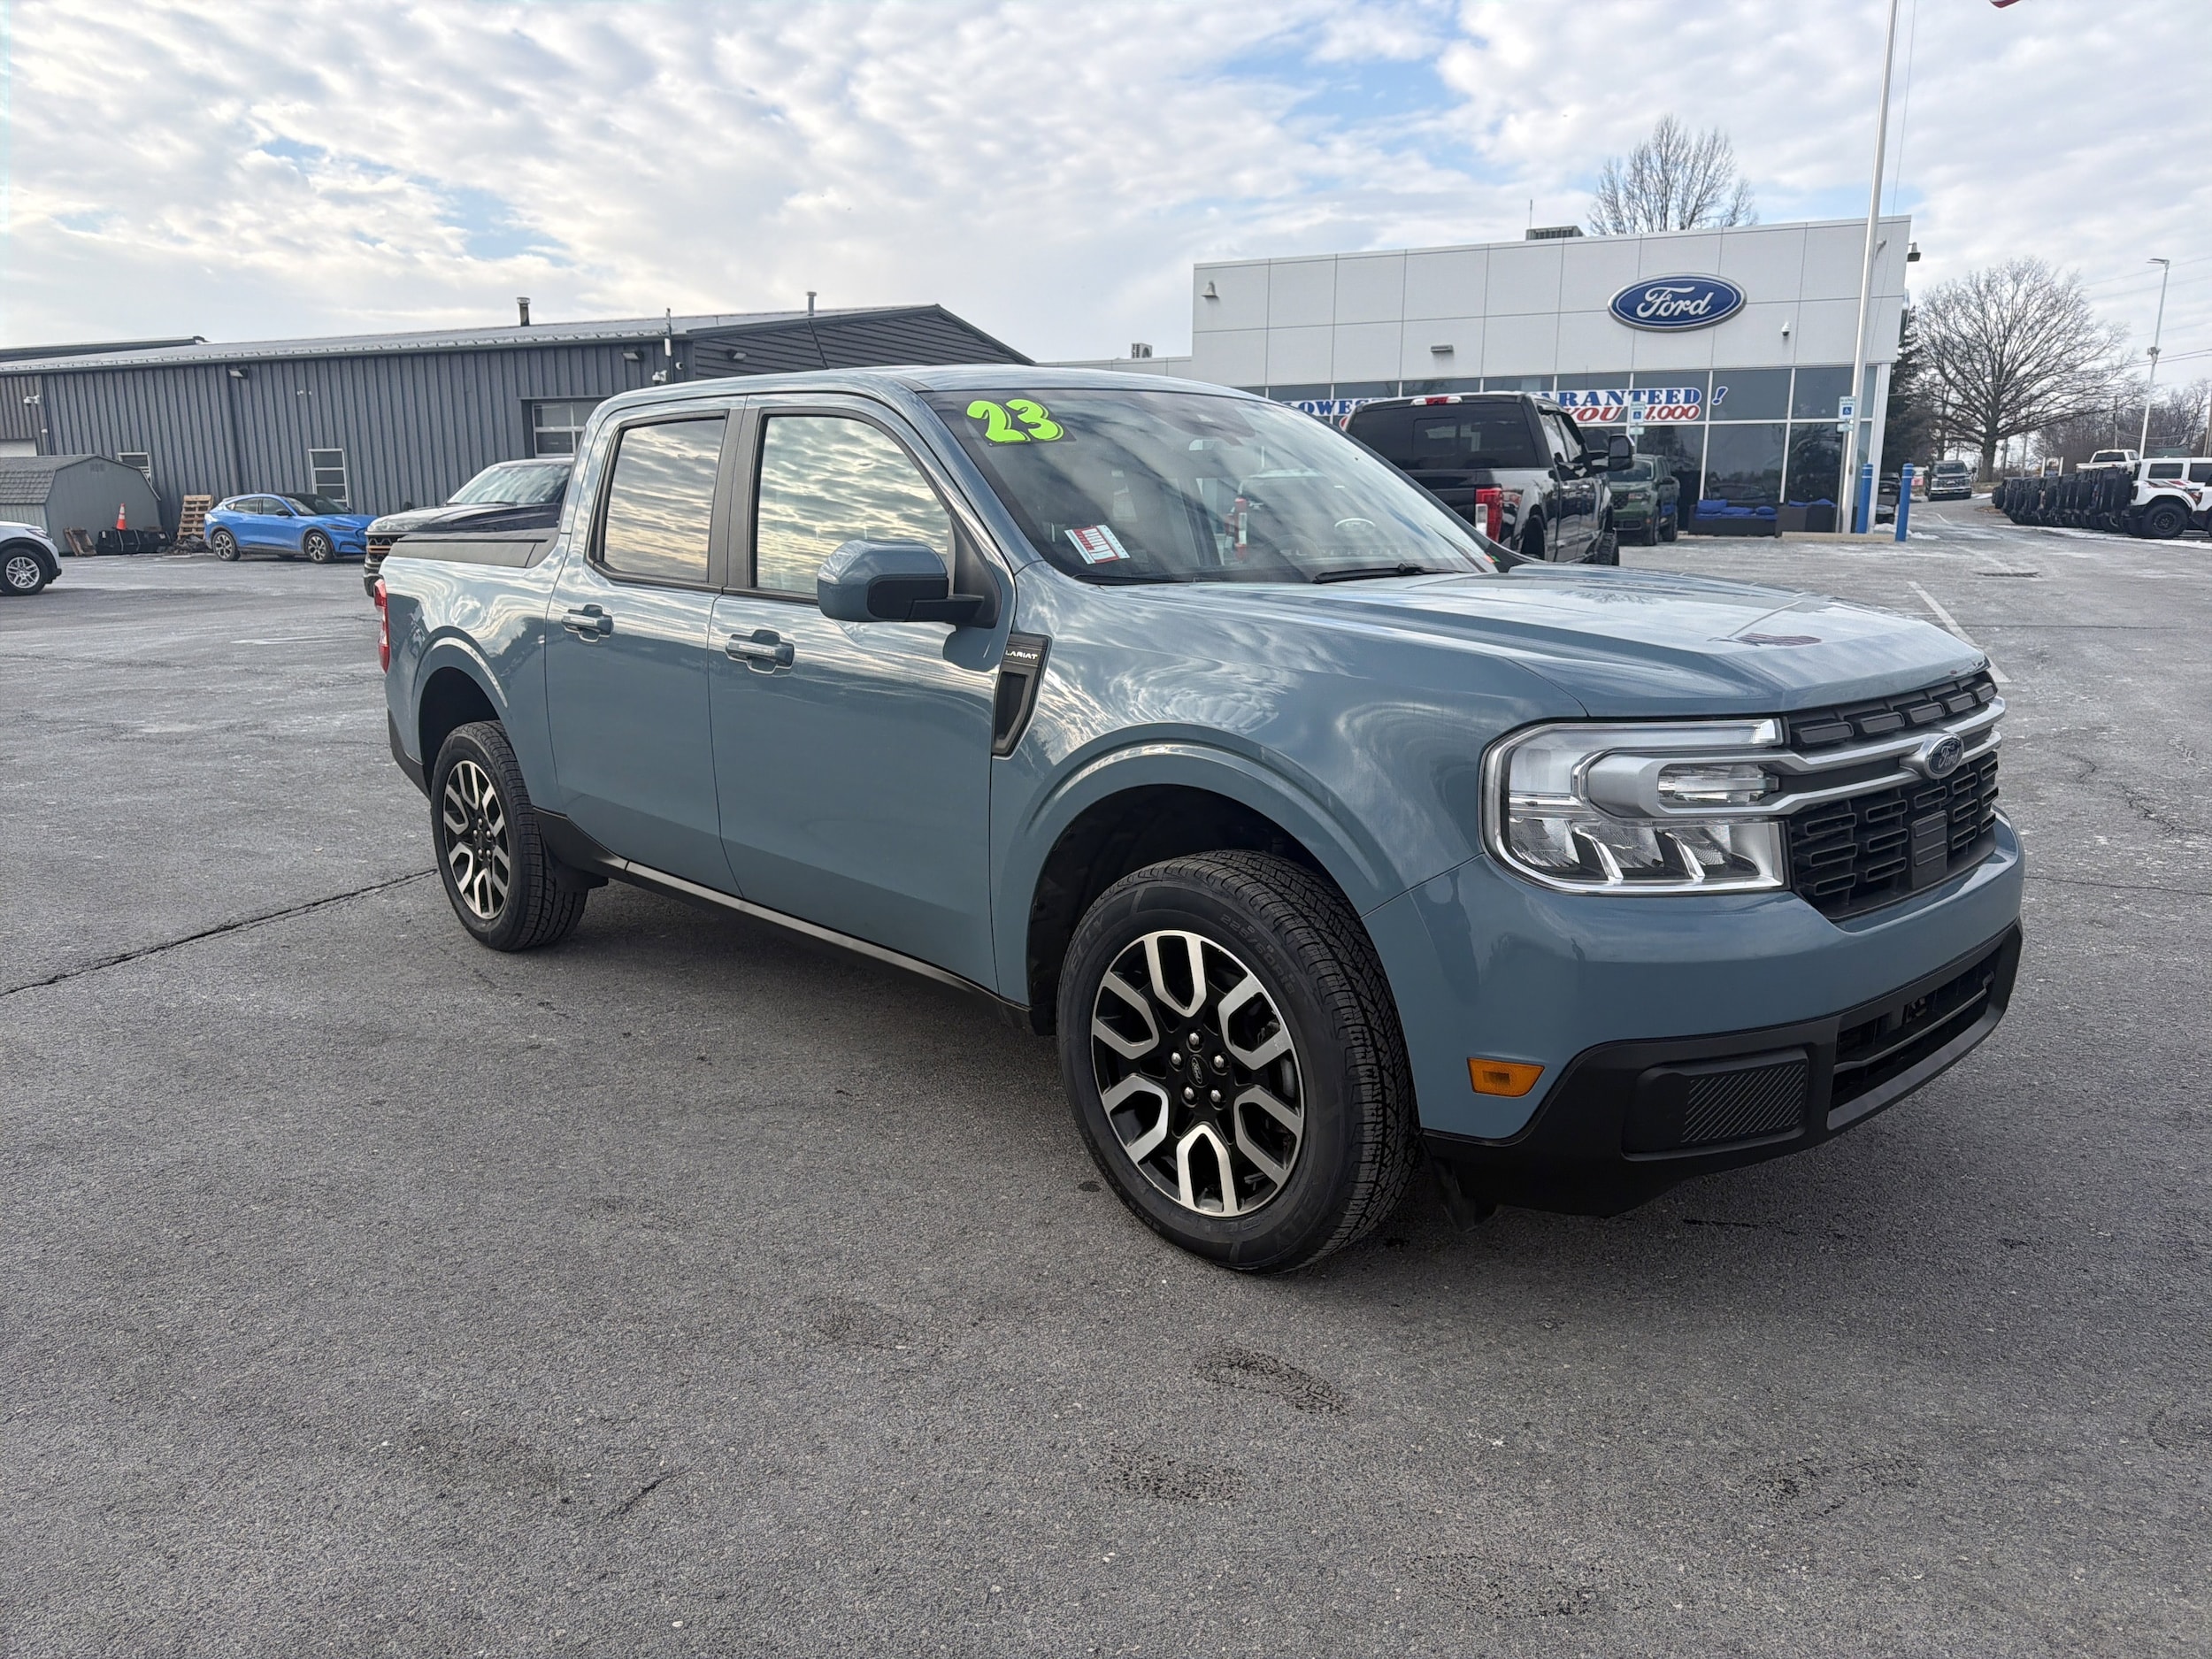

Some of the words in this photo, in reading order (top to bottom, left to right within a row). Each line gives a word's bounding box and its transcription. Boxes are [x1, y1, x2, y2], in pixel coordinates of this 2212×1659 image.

[1636, 286, 1714, 318] Ford
[1541, 389, 1701, 406] RANTEED
[966, 398, 1064, 442] 23
[1005, 649, 1038, 660] LARIAT
[1938, 745, 1960, 769] Ford
